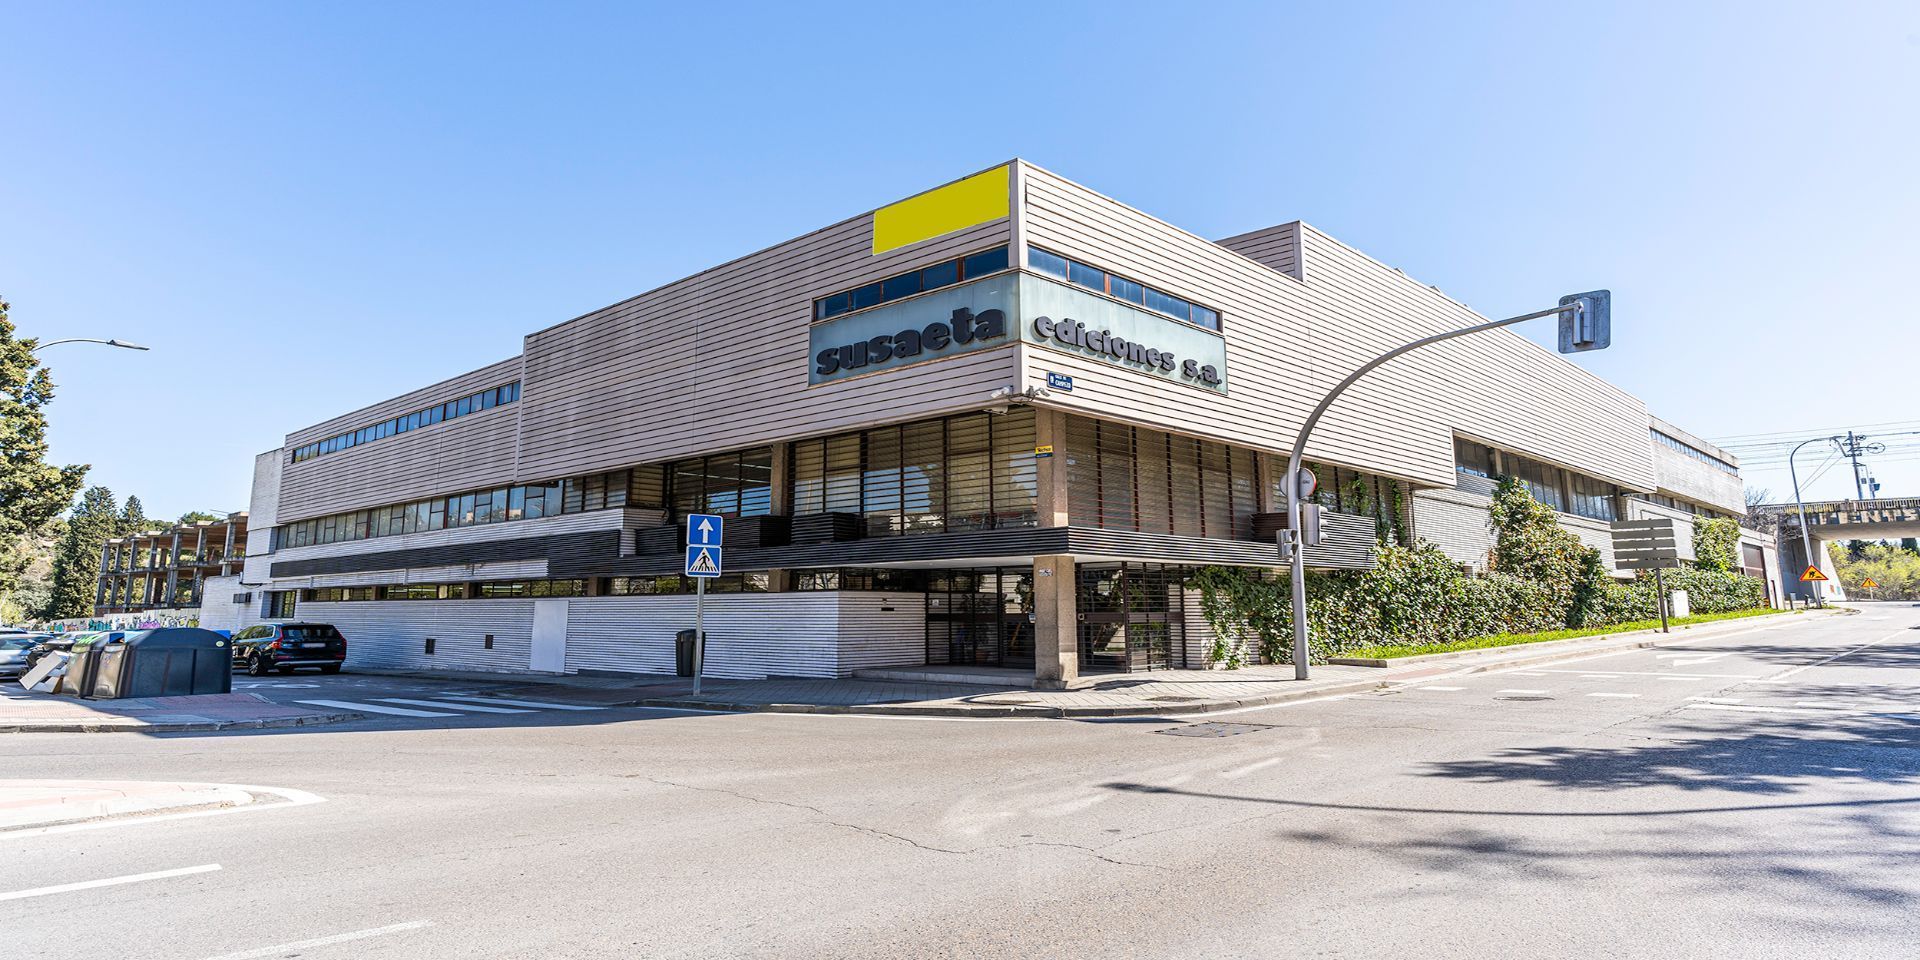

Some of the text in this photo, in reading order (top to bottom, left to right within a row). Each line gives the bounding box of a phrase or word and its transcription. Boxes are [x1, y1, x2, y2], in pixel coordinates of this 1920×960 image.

[816, 307, 1006, 375] susaeta
[1034, 316, 1223, 386] ediciones s.a.
